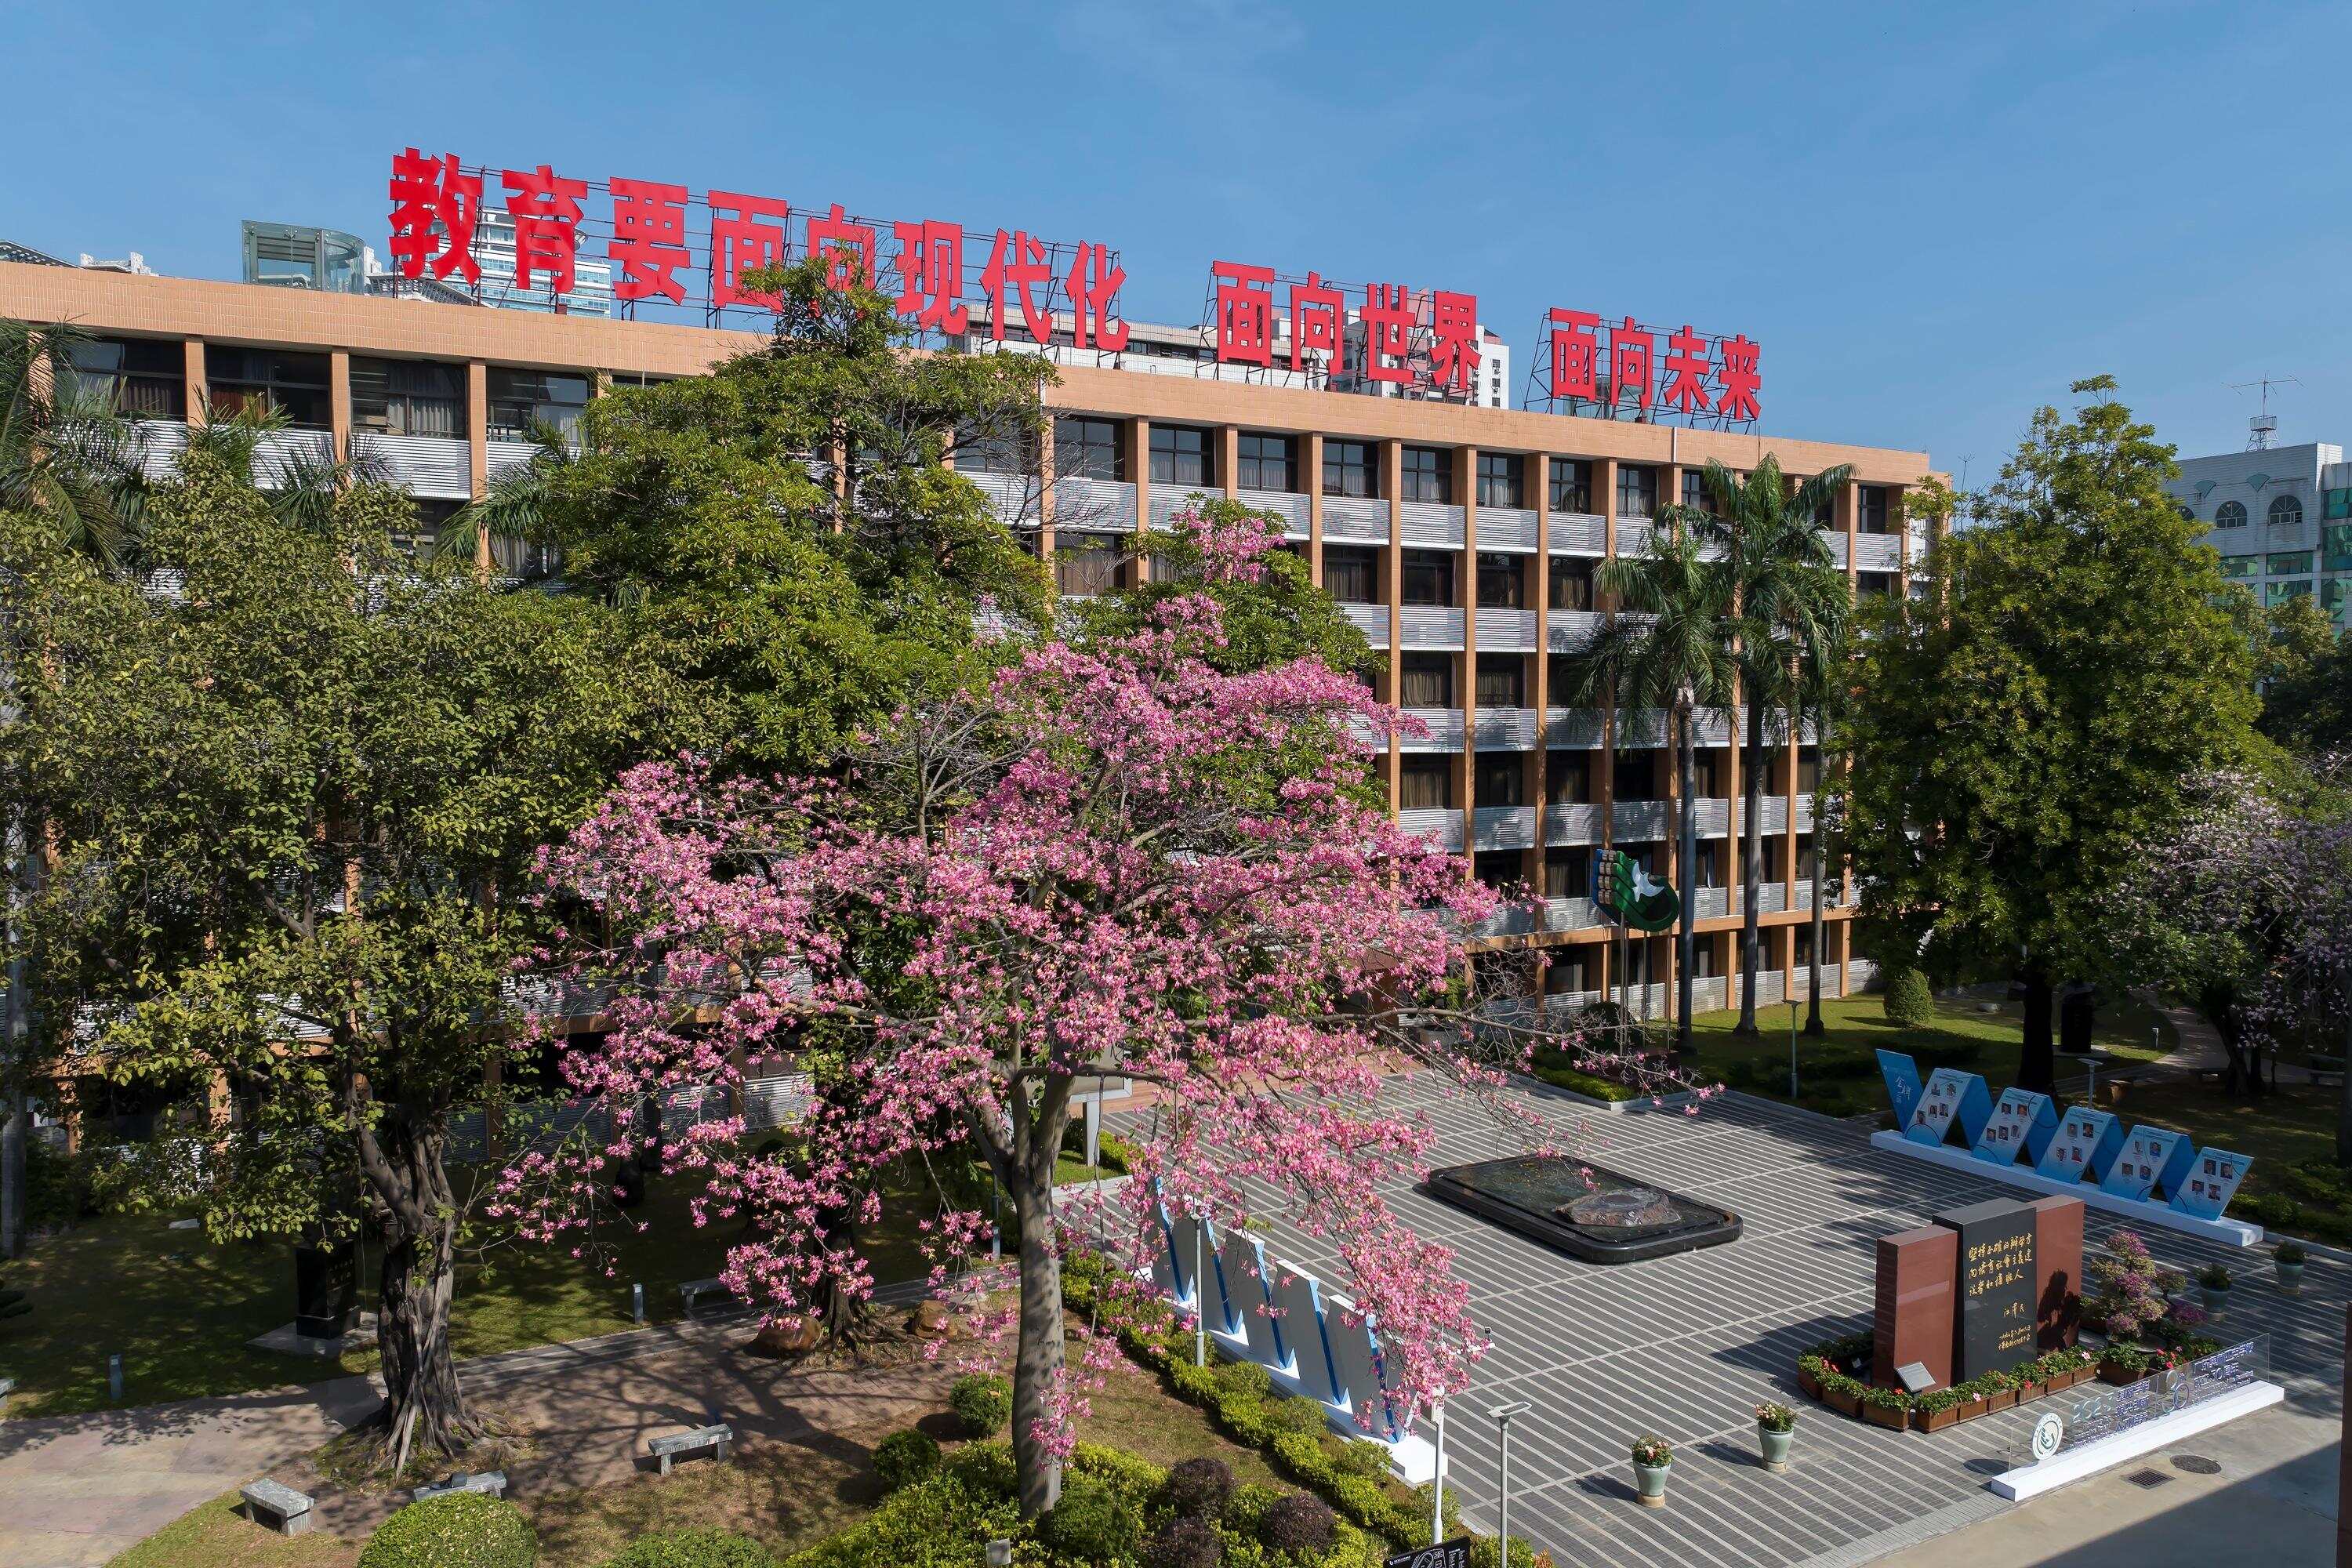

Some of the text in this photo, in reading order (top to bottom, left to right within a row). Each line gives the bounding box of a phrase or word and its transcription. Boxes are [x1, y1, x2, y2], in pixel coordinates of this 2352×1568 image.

[389, 147, 1762, 421] 教育要面向现代化 面向世界 面向未来
